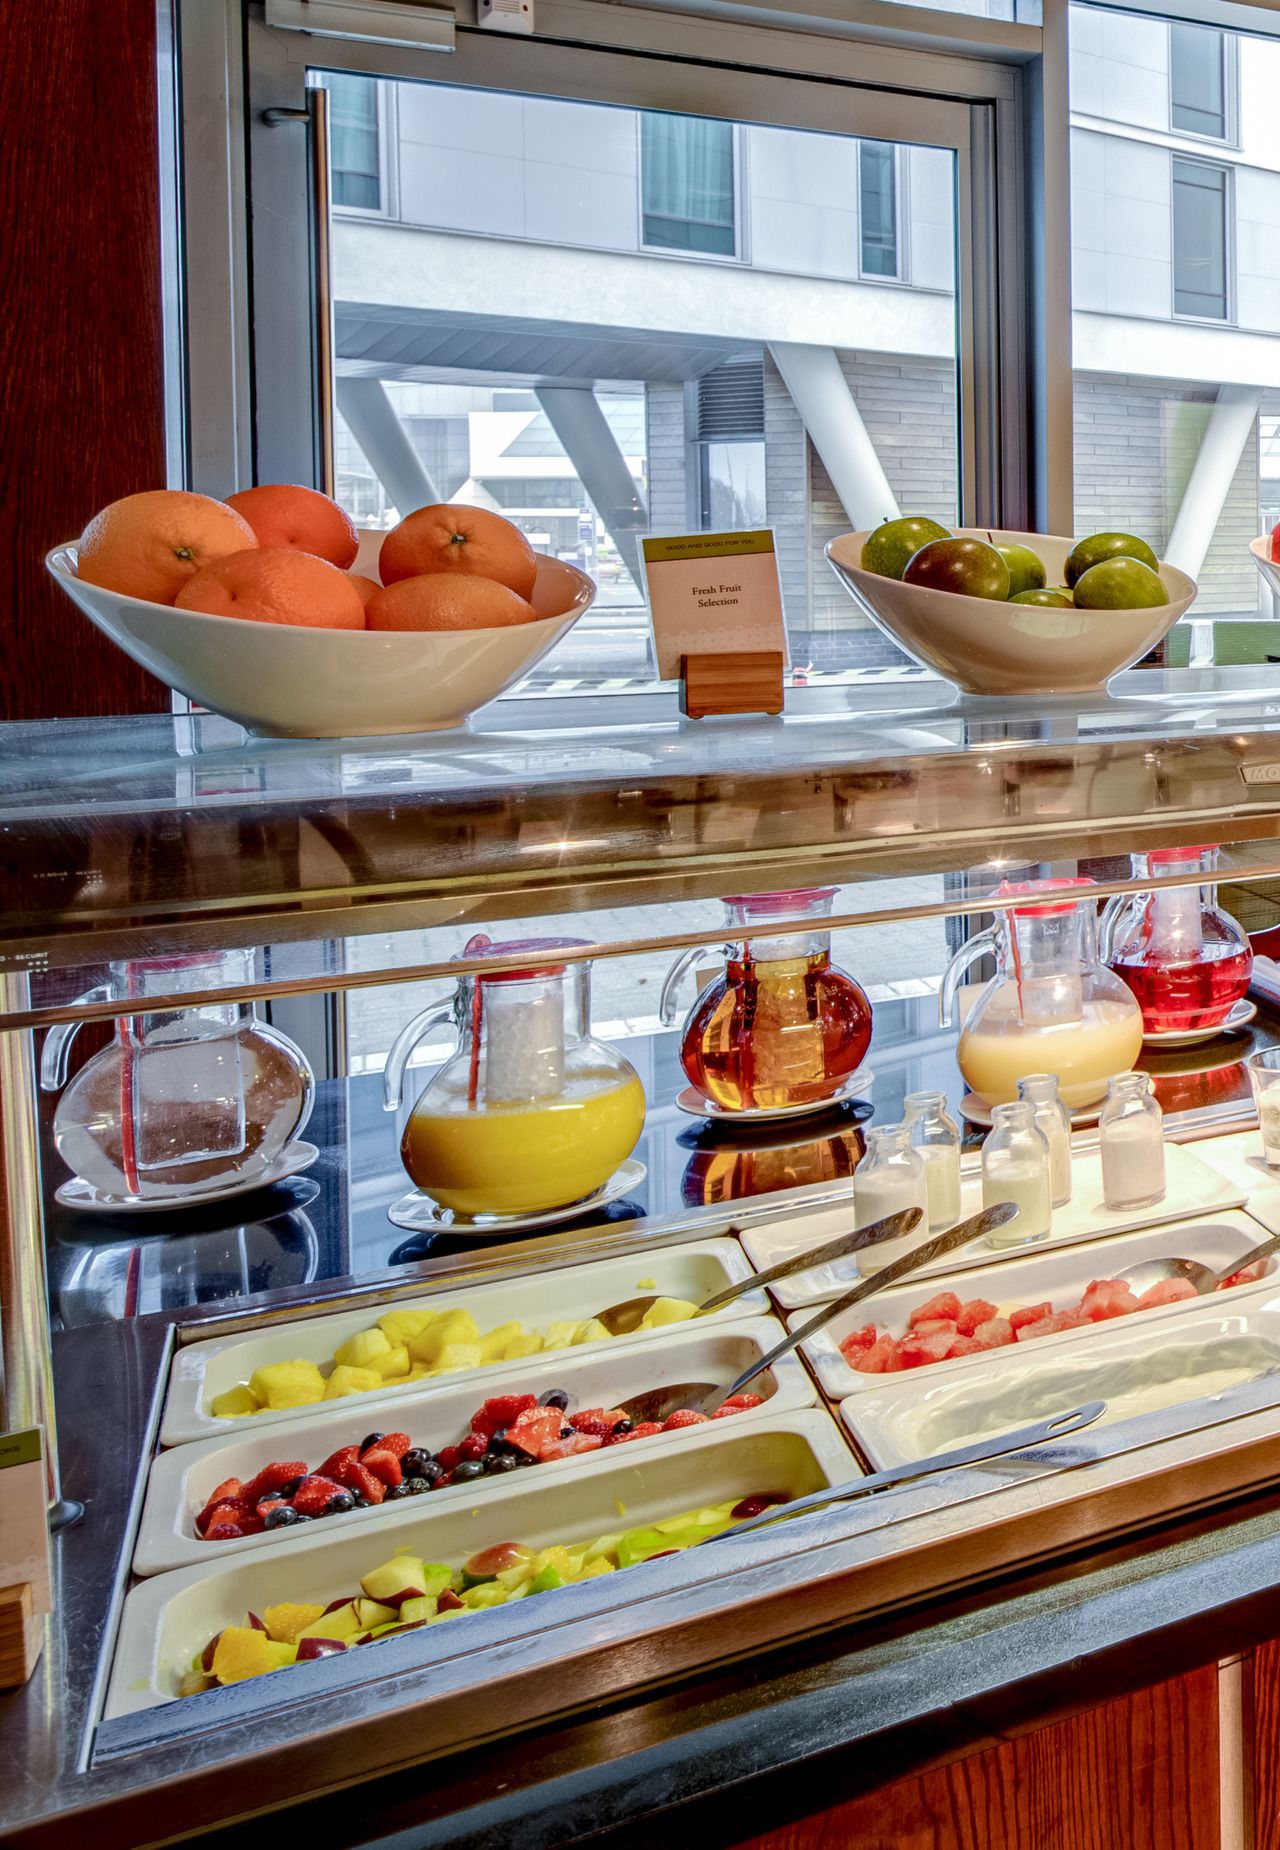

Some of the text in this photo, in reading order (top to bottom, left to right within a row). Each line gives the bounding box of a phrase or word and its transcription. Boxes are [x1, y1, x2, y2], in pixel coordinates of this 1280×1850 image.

[692, 583, 742, 596] Fresh Fruit
[698, 598, 739, 608] Selection
